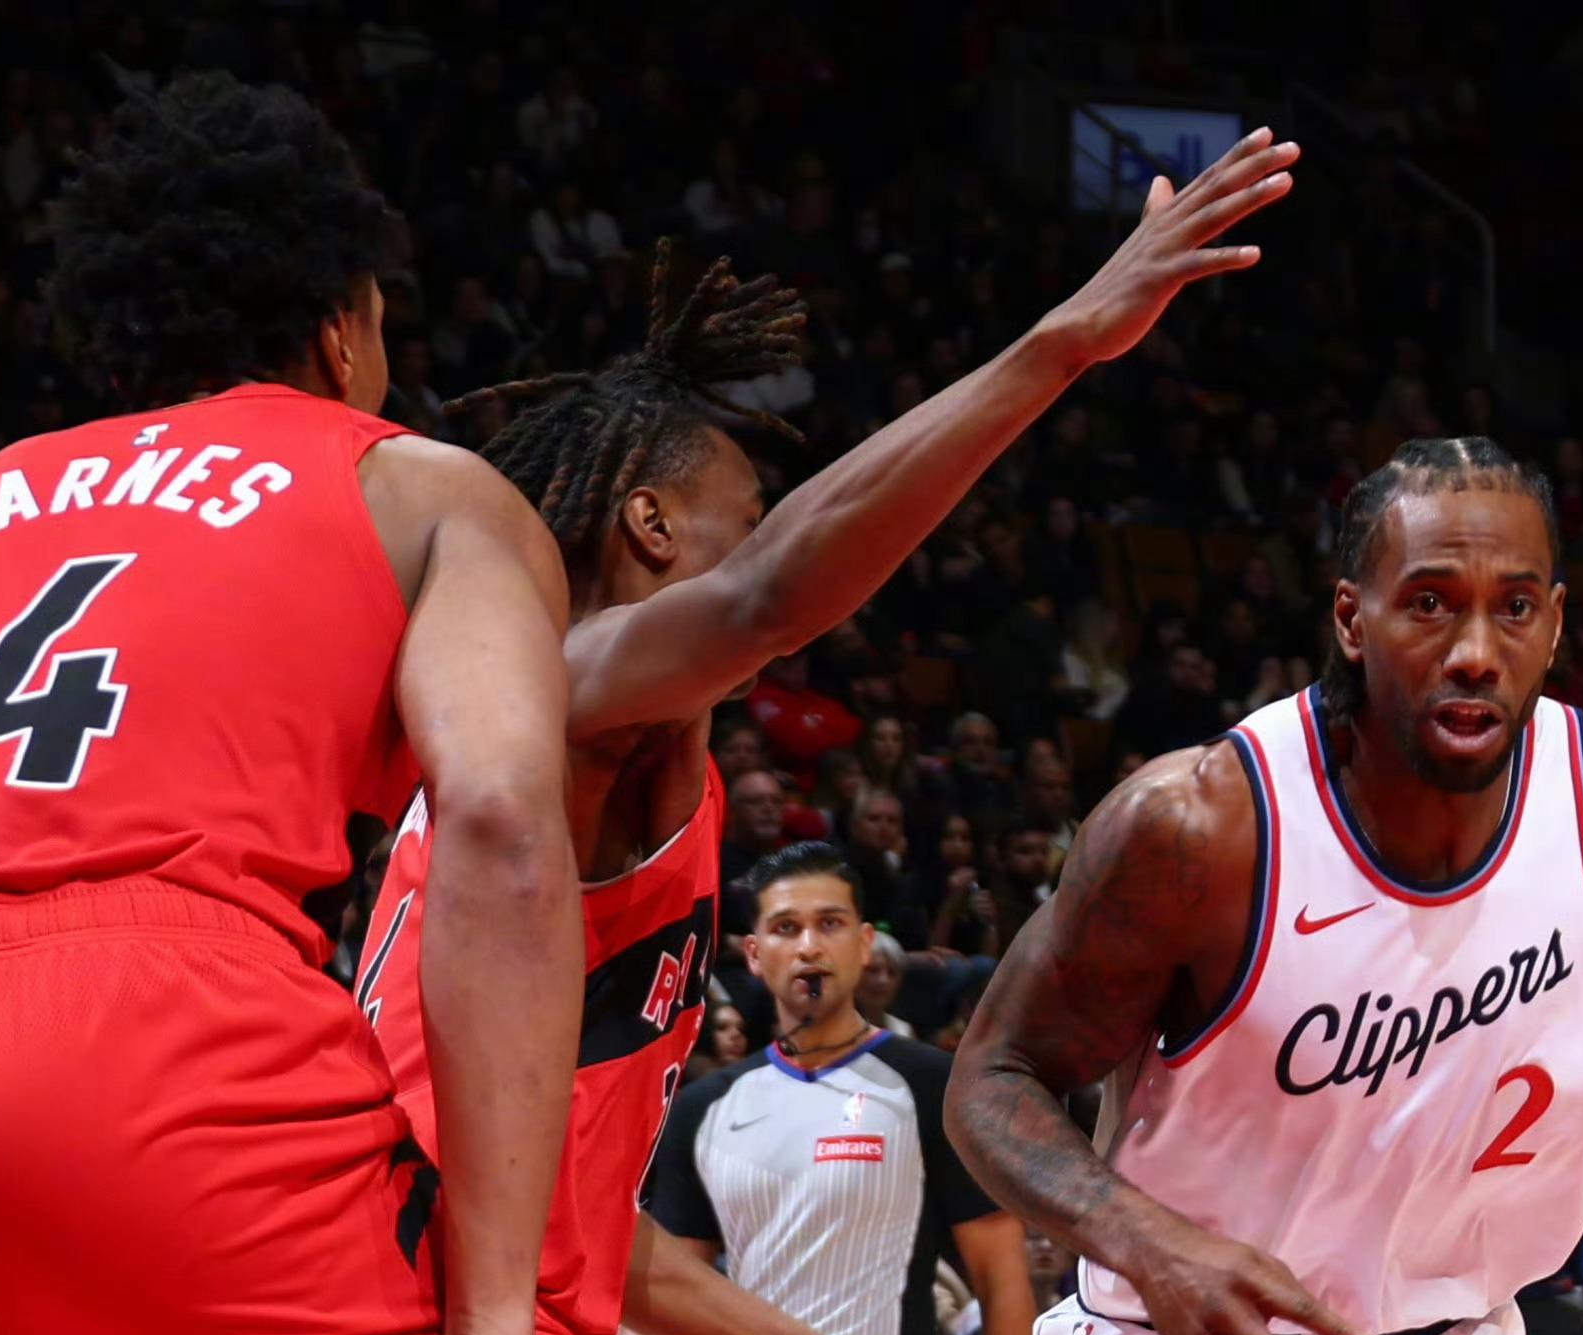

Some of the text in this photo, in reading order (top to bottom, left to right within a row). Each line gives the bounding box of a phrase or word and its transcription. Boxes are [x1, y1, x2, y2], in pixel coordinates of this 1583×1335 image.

[1274, 927, 1575, 1098] Clippers
[817, 1140, 883, 1157] Emirates
[1471, 1063, 1555, 1174] 2
